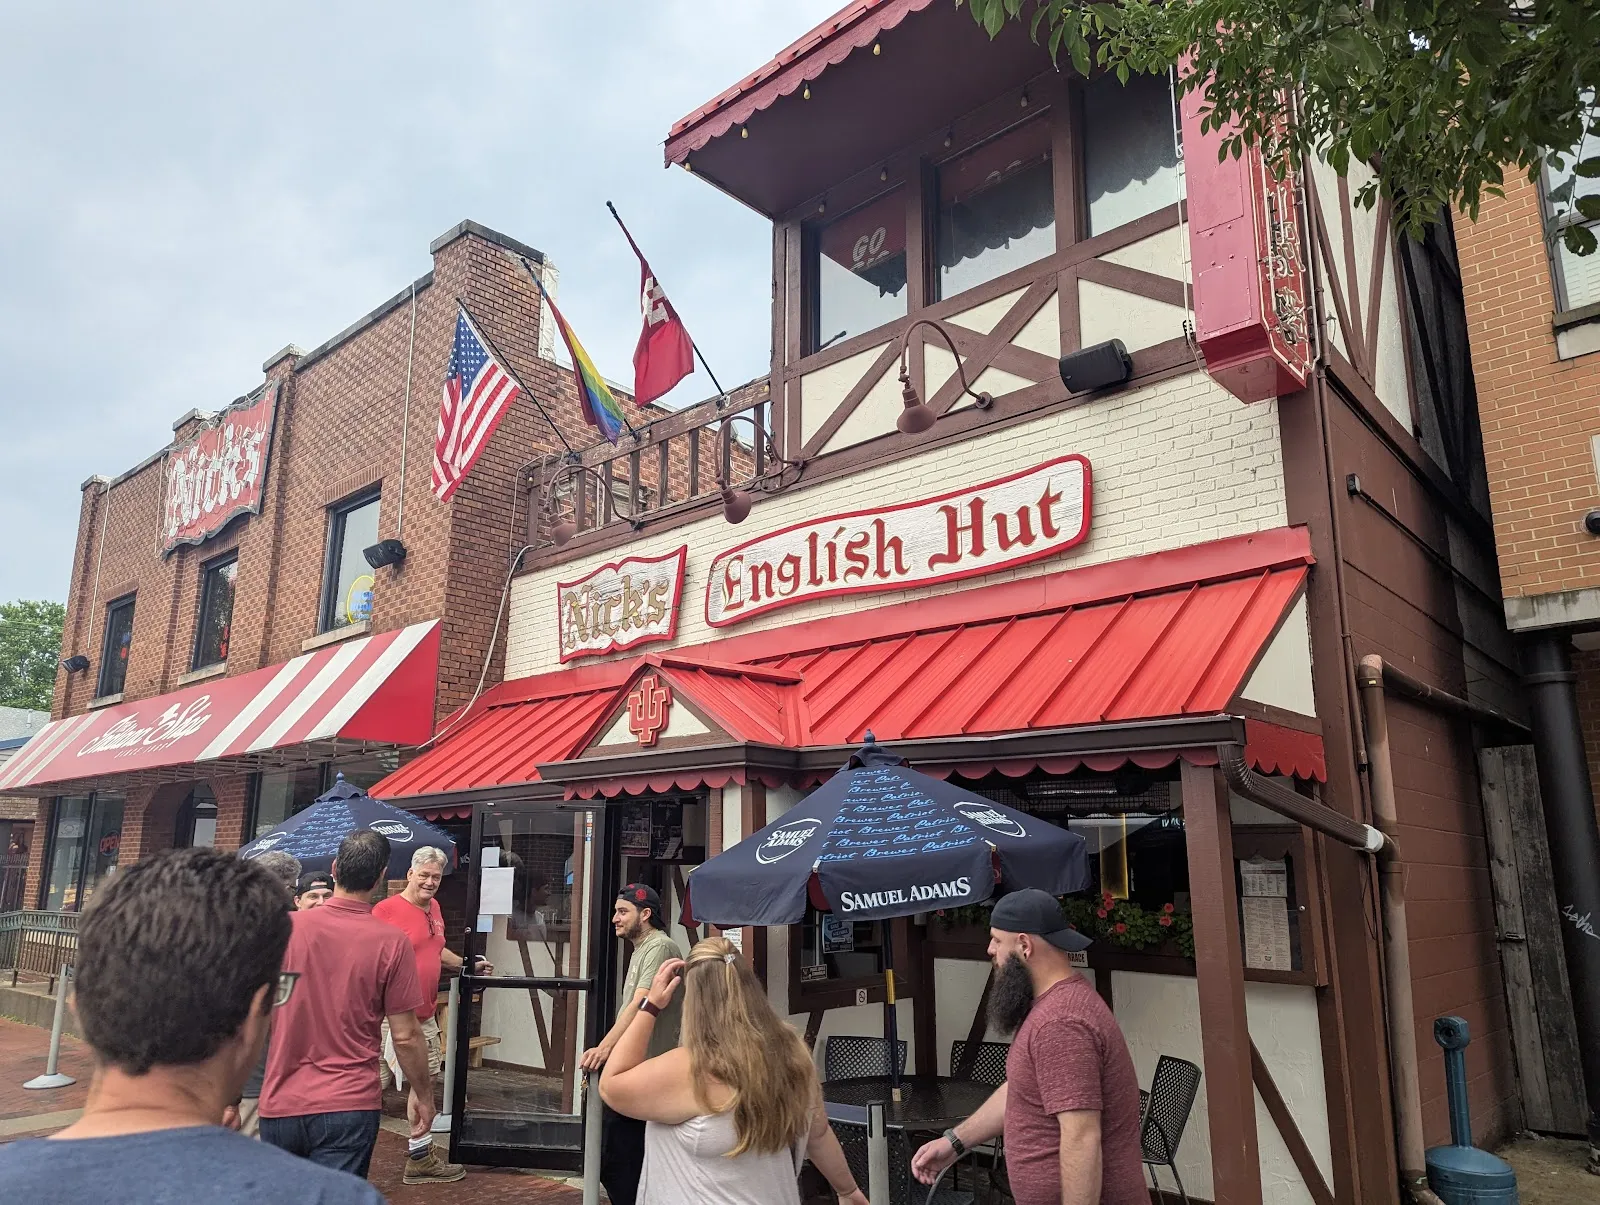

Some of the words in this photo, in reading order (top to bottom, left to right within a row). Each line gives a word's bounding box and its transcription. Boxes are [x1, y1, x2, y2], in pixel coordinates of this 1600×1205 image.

[853, 227, 886, 262] GO
[722, 518, 911, 613] English
[928, 478, 1063, 572] Hut
[565, 574, 669, 649] Nick's
[833, 815, 883, 824] Brewer
[887, 809, 938, 822] Patriot
[853, 804, 903, 813] Brewer
[767, 826, 818, 840] SAMUEL
[836, 838, 890, 849] Brewer
[893, 830, 946, 844] Patriot
[858, 825, 911, 836] Brewer
[761, 837, 806, 848] ADAMS
[863, 848, 918, 859] Brewer
[922, 836, 977, 853] Patriot
[840, 889, 908, 912] SAMUEL
[909, 877, 971, 901] ADAMS
